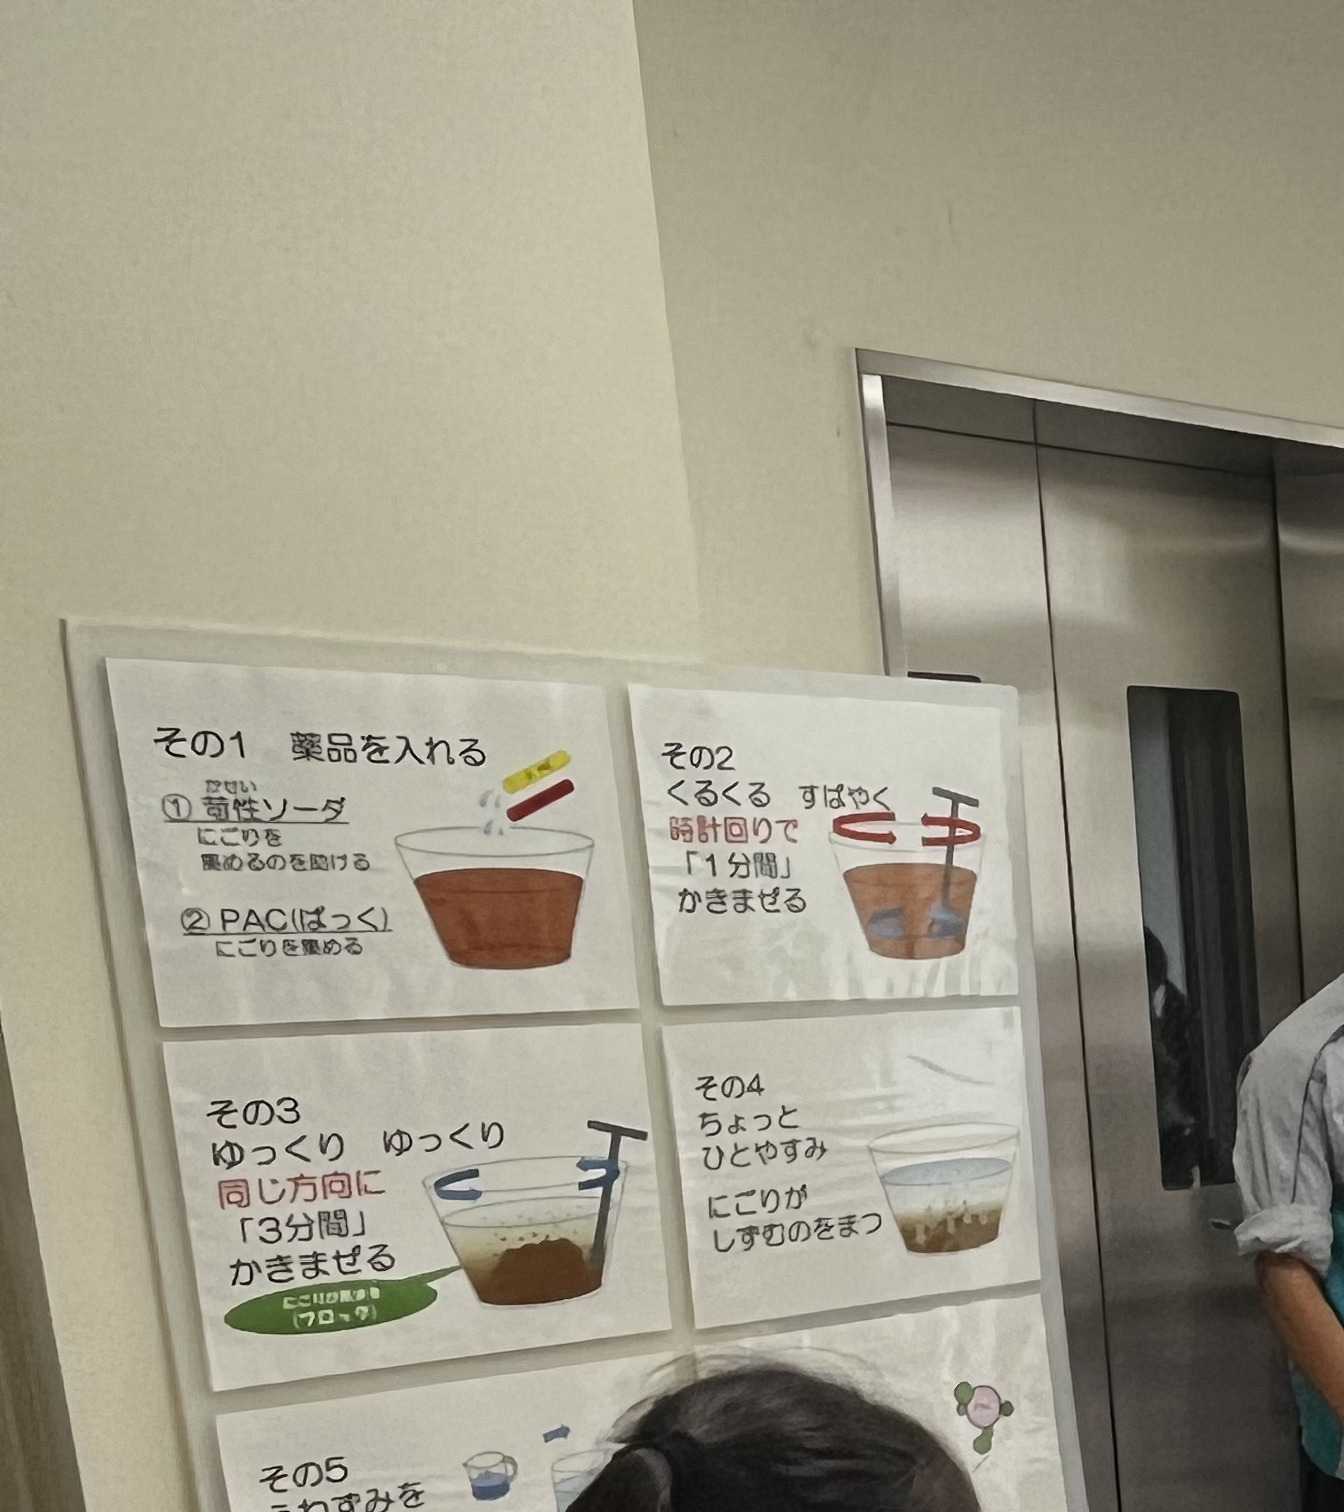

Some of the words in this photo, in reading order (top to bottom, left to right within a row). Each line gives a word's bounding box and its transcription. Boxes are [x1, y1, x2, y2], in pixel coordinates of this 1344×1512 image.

[153, 727, 246, 759] その1
[290, 731, 487, 767] 薬品を入れる
[661, 742, 736, 771] その2
[667, 779, 771, 808] くるくる
[669, 814, 799, 844] 時計回りで
[678, 886, 807, 915] かきまぜる
[695, 1072, 766, 1102] その4
[206, 1096, 301, 1130] その3
[698, 1104, 800, 1138] ちょっと
[211, 1131, 345, 1170] ゆっくり
[382, 1120, 505, 1157] ゆっくり
[701, 1136, 829, 1171] ひとやすみ
[217, 1169, 387, 1210] 同じ方向に
[708, 1183, 809, 1220] にごりが
[713, 1212, 883, 1253] しずむのをまつ
[229, 1243, 396, 1287] かきまぜる
[259, 1455, 349, 1494] その5
